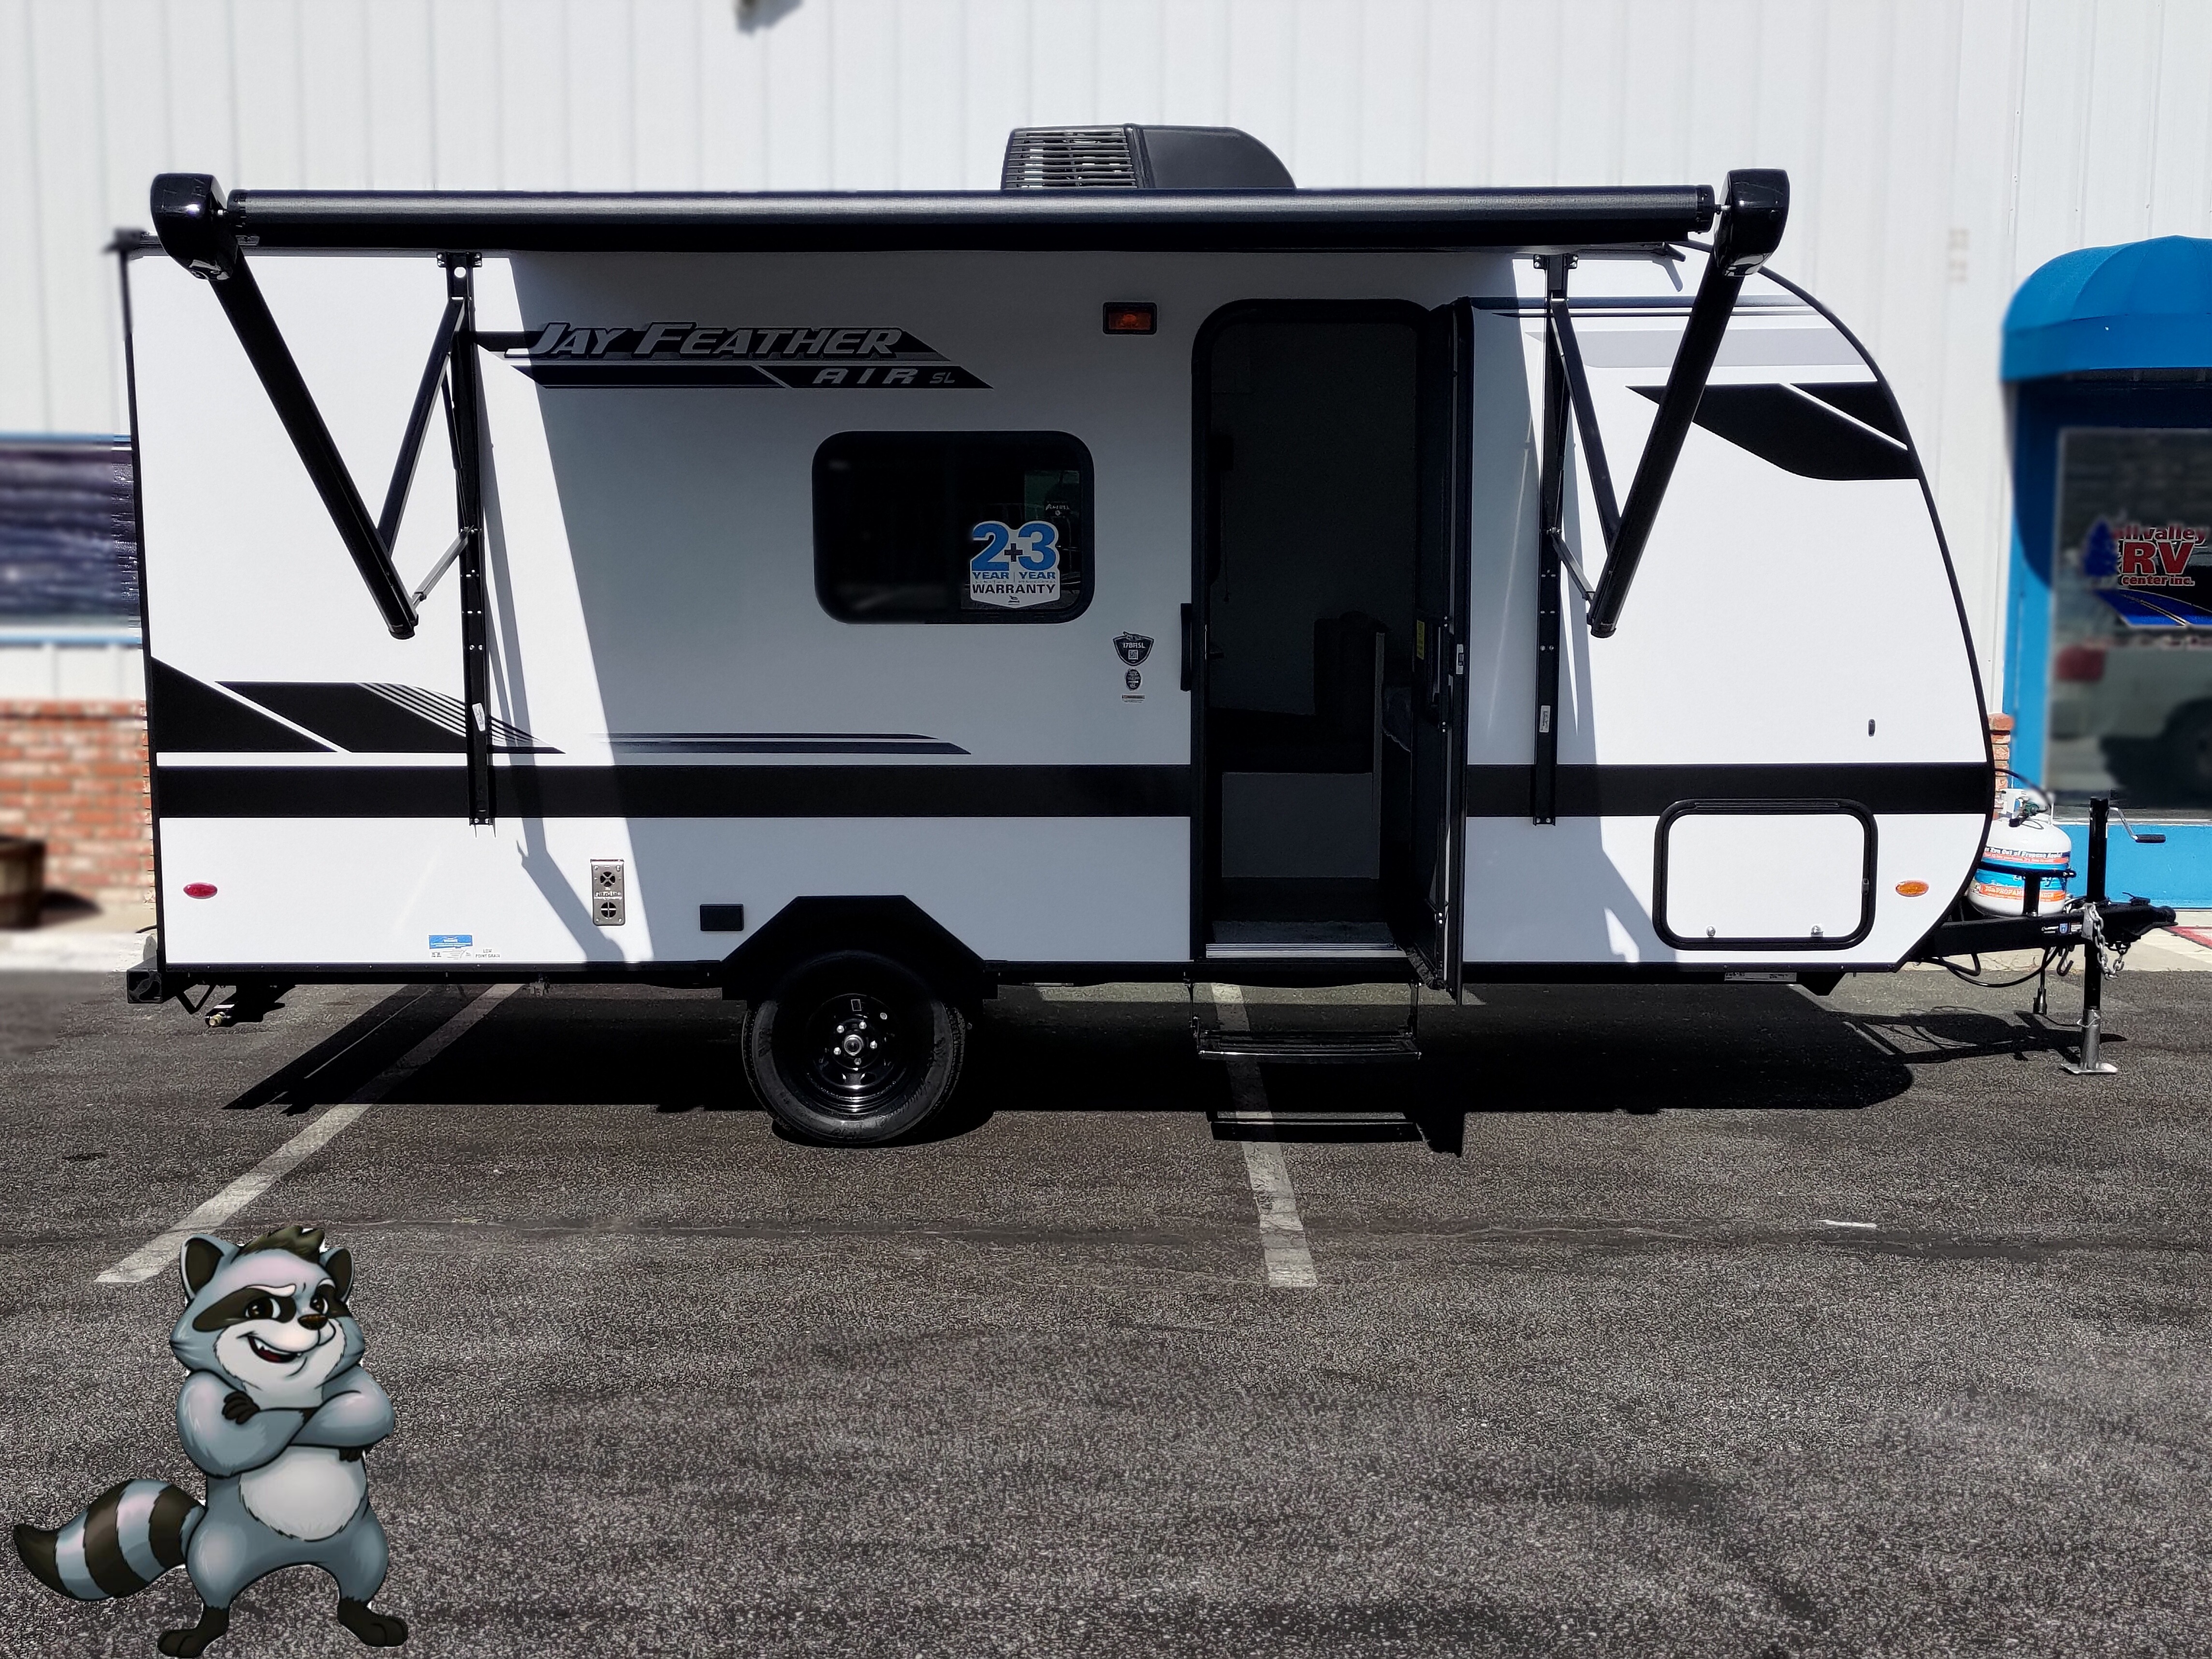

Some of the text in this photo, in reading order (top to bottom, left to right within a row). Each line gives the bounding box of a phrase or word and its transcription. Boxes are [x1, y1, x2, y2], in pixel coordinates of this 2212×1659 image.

[507, 322, 902, 354] JAY FEATHER
[812, 368, 955, 384] AIR SL
[2123, 541, 2195, 574] RV
[972, 571, 1056, 580] YEAR YEAR
[972, 584, 1056, 594] WARRANTY
